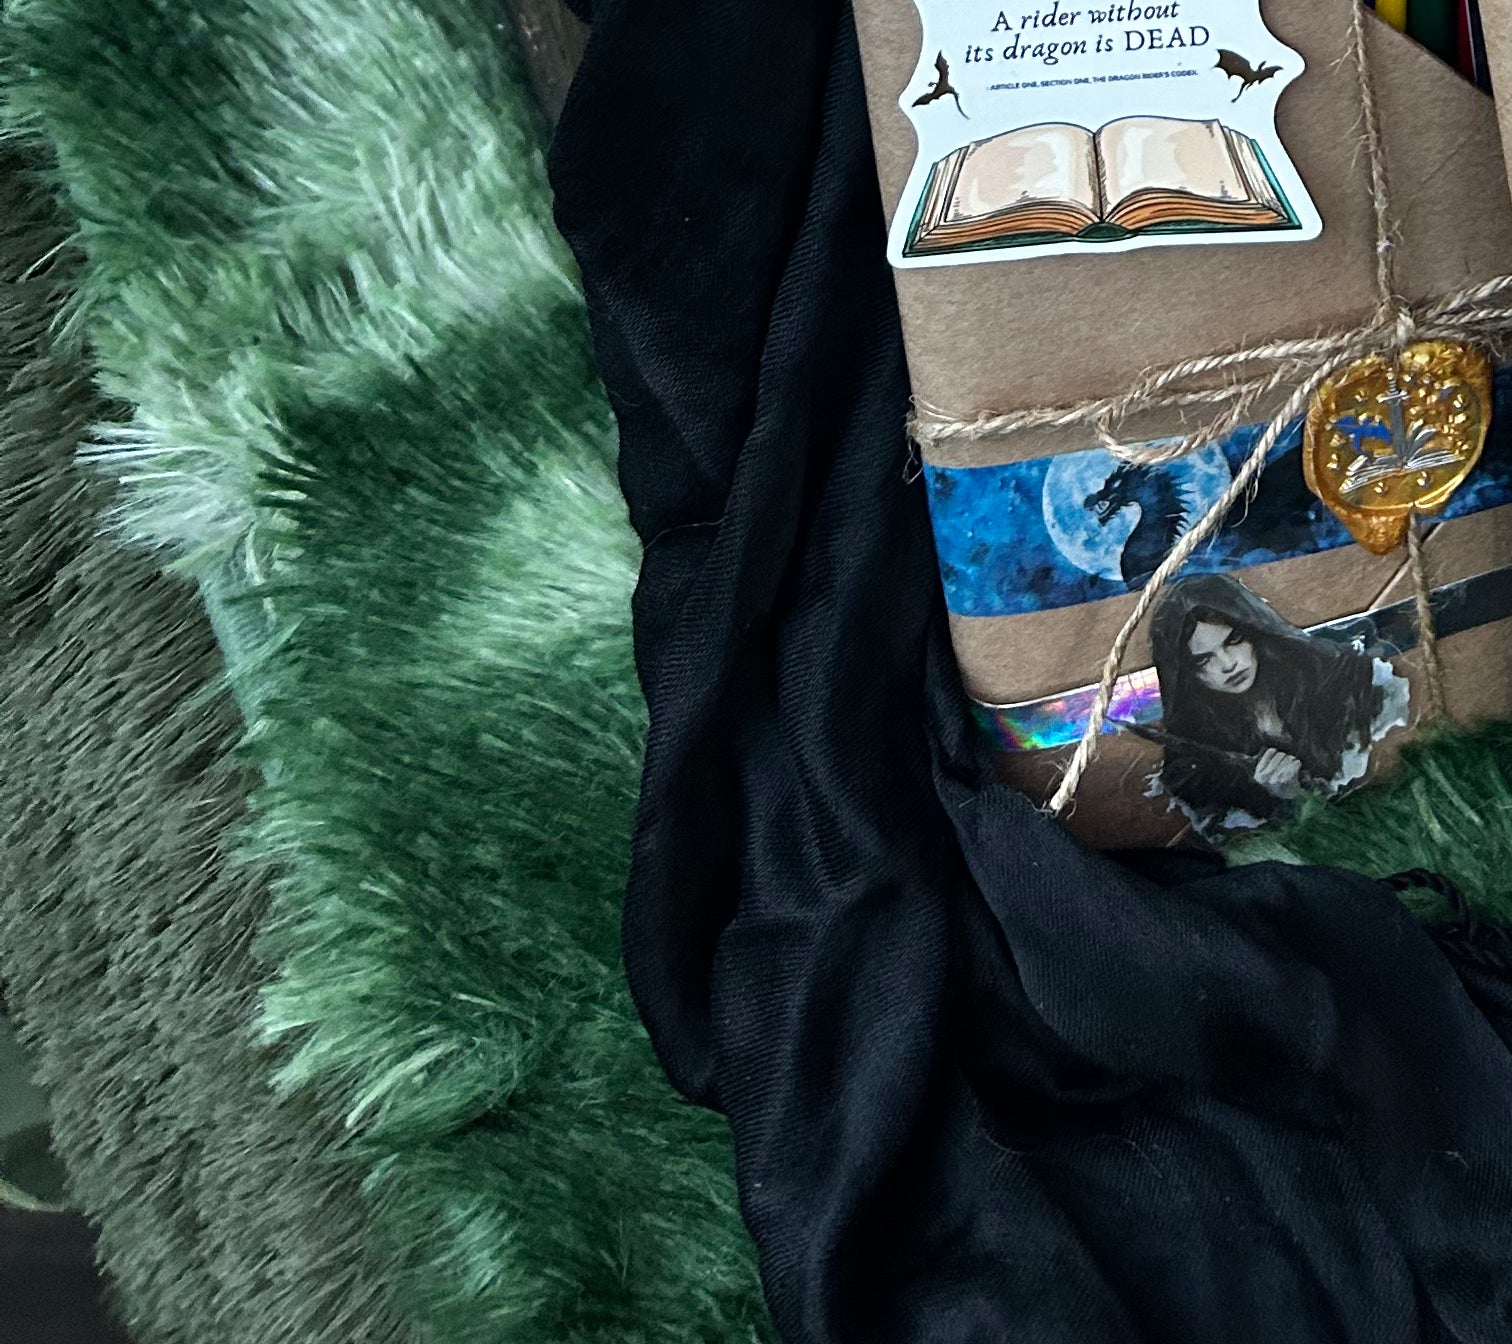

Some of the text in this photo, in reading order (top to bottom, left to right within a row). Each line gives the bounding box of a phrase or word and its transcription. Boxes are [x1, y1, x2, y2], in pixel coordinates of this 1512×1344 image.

[990, 11, 1013, 32] A
[1020, 0, 1081, 29] rider
[965, 25, 1210, 65] its dragon is DEAD
